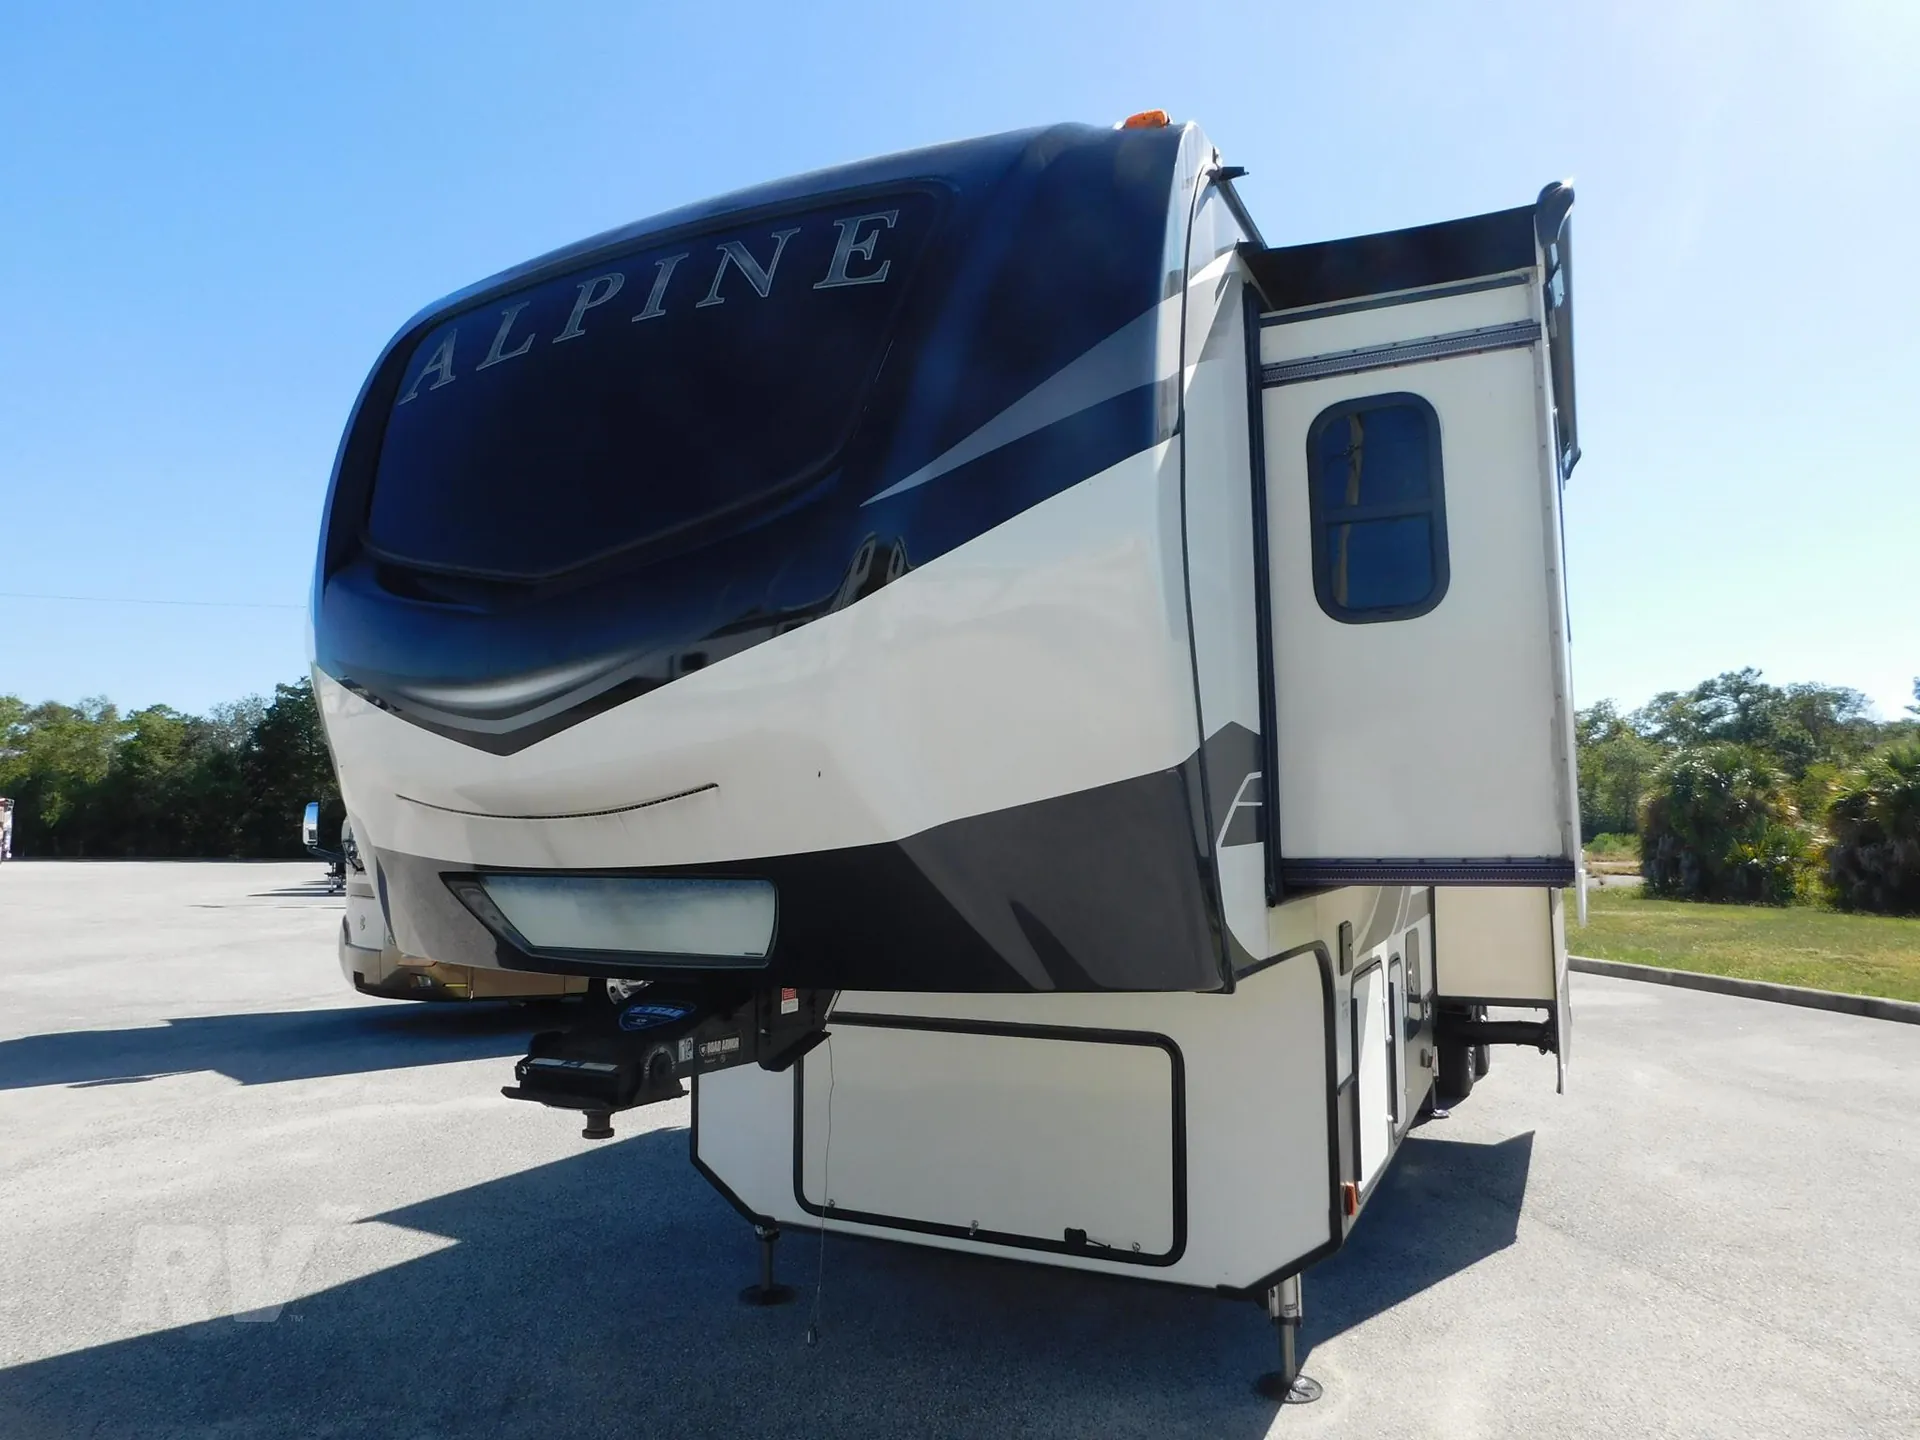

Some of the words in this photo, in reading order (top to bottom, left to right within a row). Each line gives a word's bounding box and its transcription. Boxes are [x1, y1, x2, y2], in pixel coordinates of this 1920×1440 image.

[398, 209, 900, 406] ALPINE
[707, 1040, 722, 1053] ROAD
[722, 1037, 740, 1051] ARMOR
